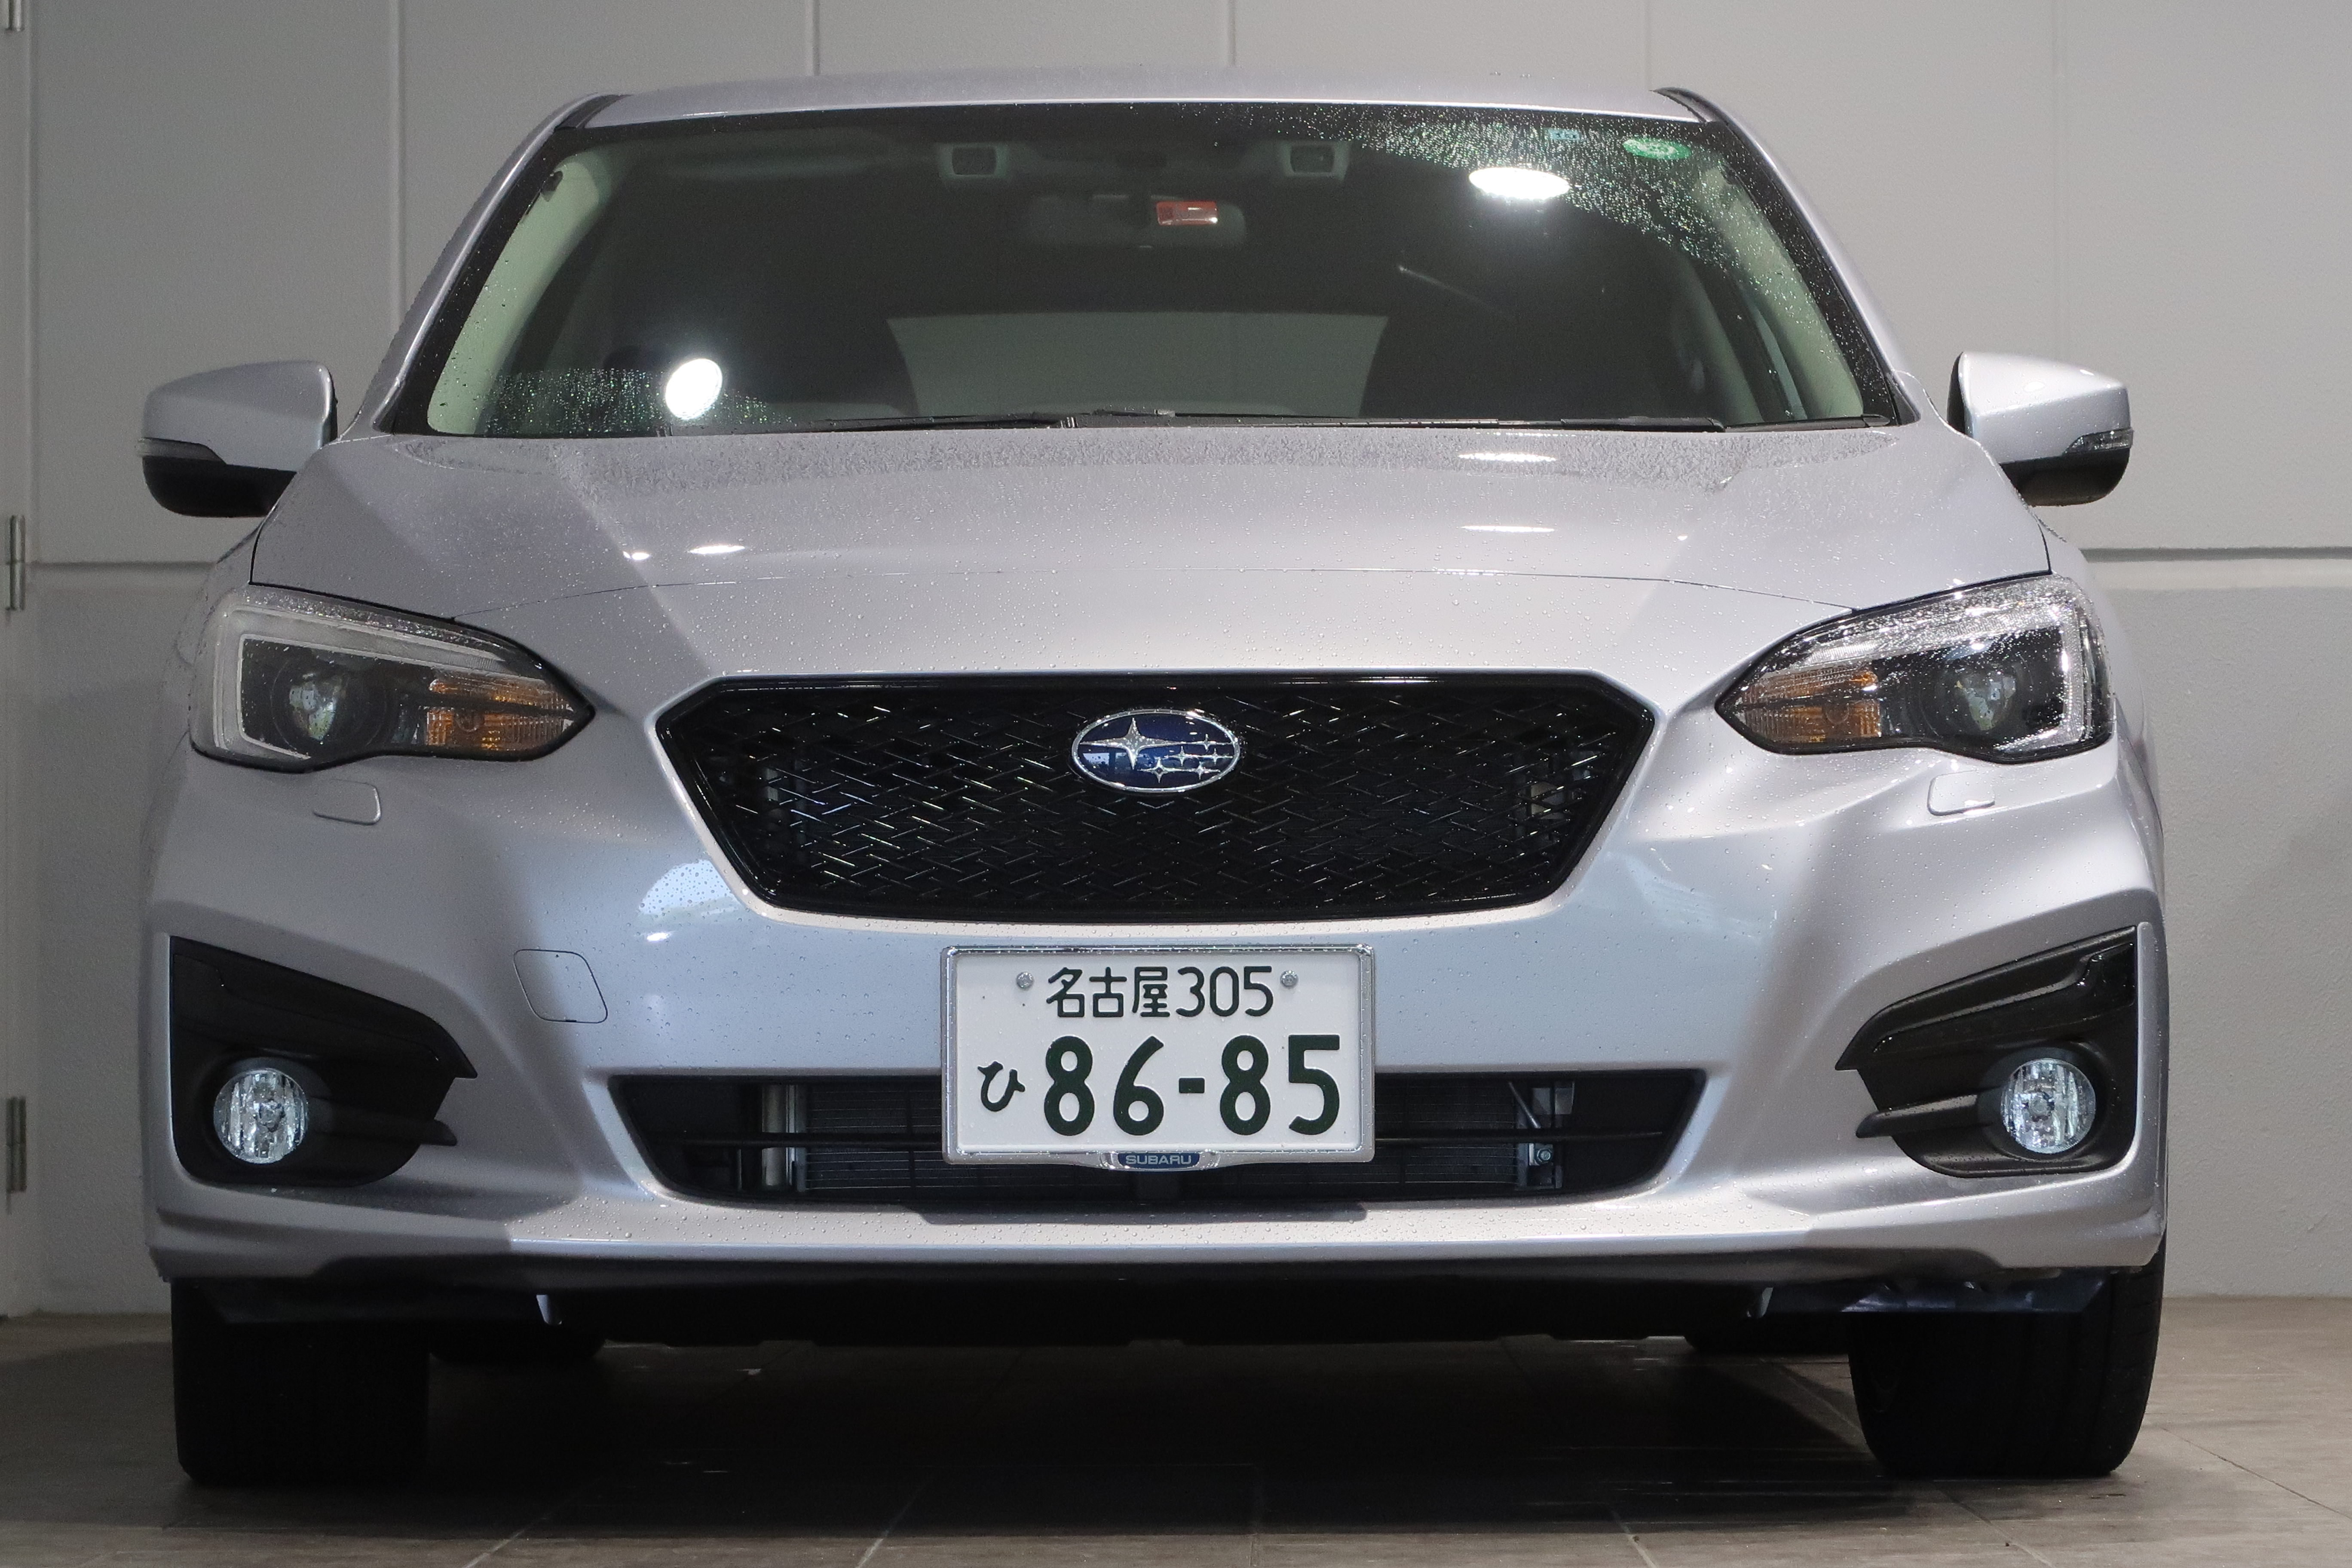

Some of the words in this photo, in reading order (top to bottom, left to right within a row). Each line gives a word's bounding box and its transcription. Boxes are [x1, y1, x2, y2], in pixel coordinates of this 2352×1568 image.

[1045, 966, 1274, 1018] 名古屋305
[977, 1060, 1026, 1113] ひ
[1043, 1034, 1341, 1137] 86-85
[1125, 1155, 1192, 1165] SUBARU
